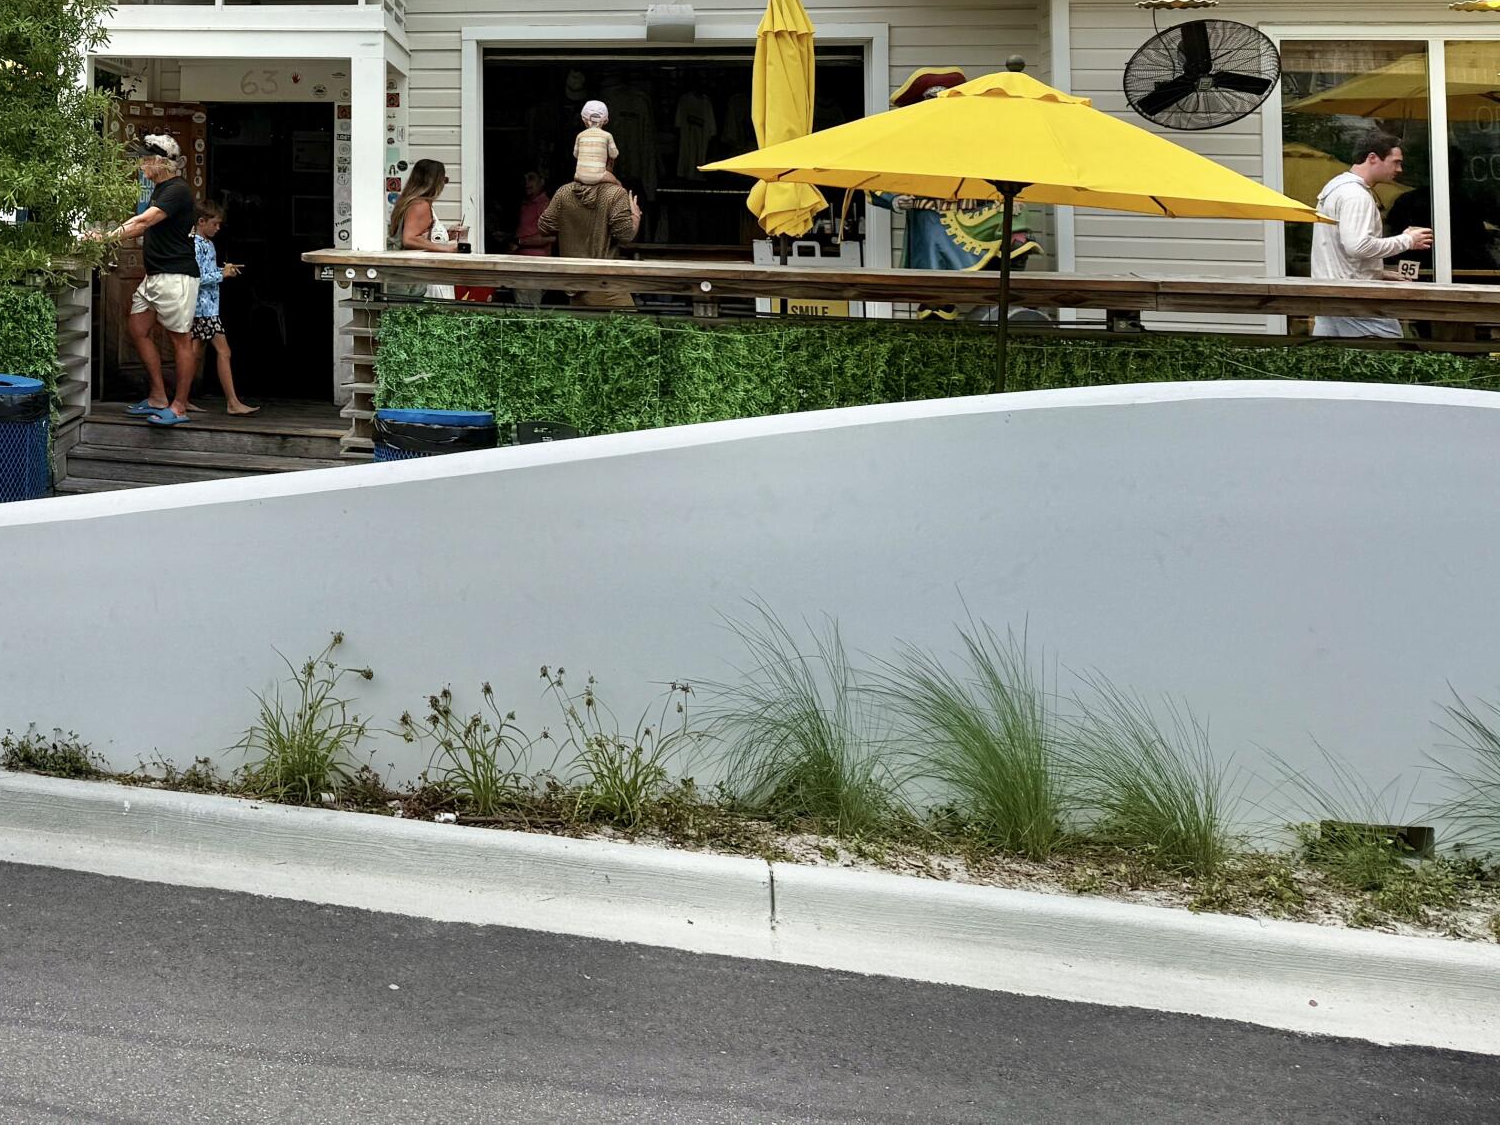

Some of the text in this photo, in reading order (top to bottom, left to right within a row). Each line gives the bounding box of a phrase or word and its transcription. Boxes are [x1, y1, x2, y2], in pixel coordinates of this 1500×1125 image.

[241, 70, 278, 95] 63
[1401, 263, 1416, 276] 95
[791, 305, 829, 315] SMILE
